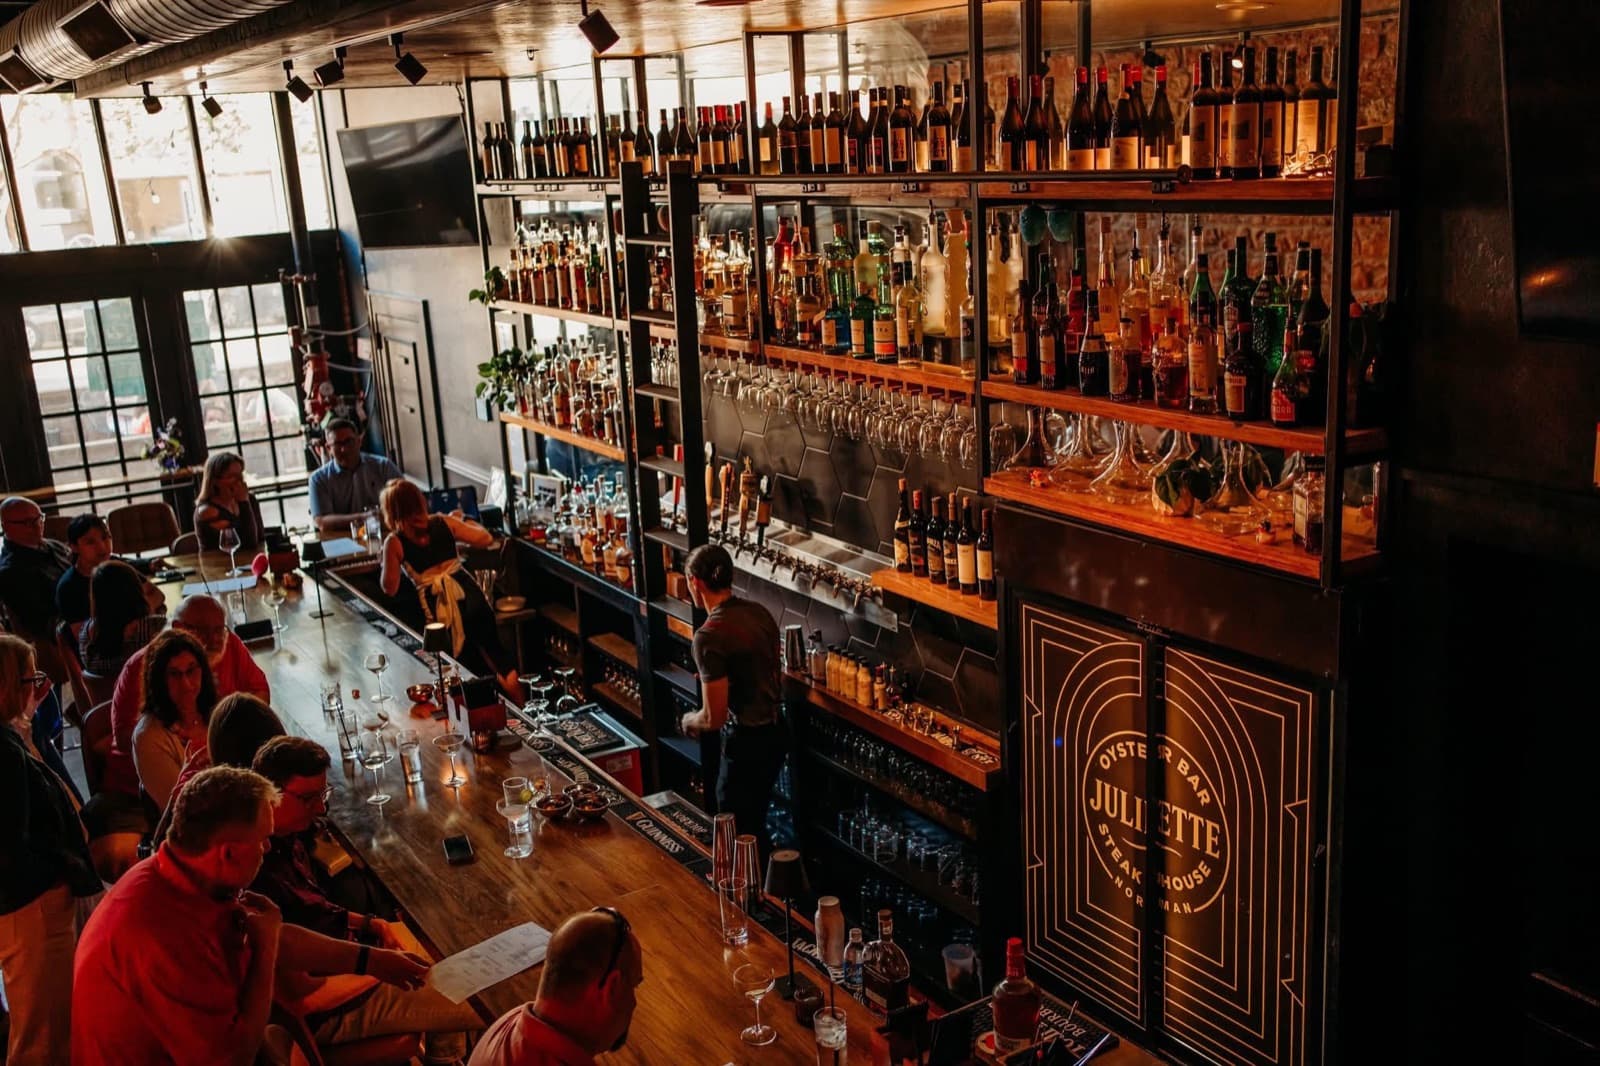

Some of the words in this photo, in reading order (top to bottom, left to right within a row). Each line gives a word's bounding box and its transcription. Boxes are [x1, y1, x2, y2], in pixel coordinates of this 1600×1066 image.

[1099, 740, 1172, 770] OYSTER
[1177, 758, 1211, 807] BAR
[1089, 778, 1221, 859] JULIETTE
[1114, 876, 1193, 915] NORMAN
